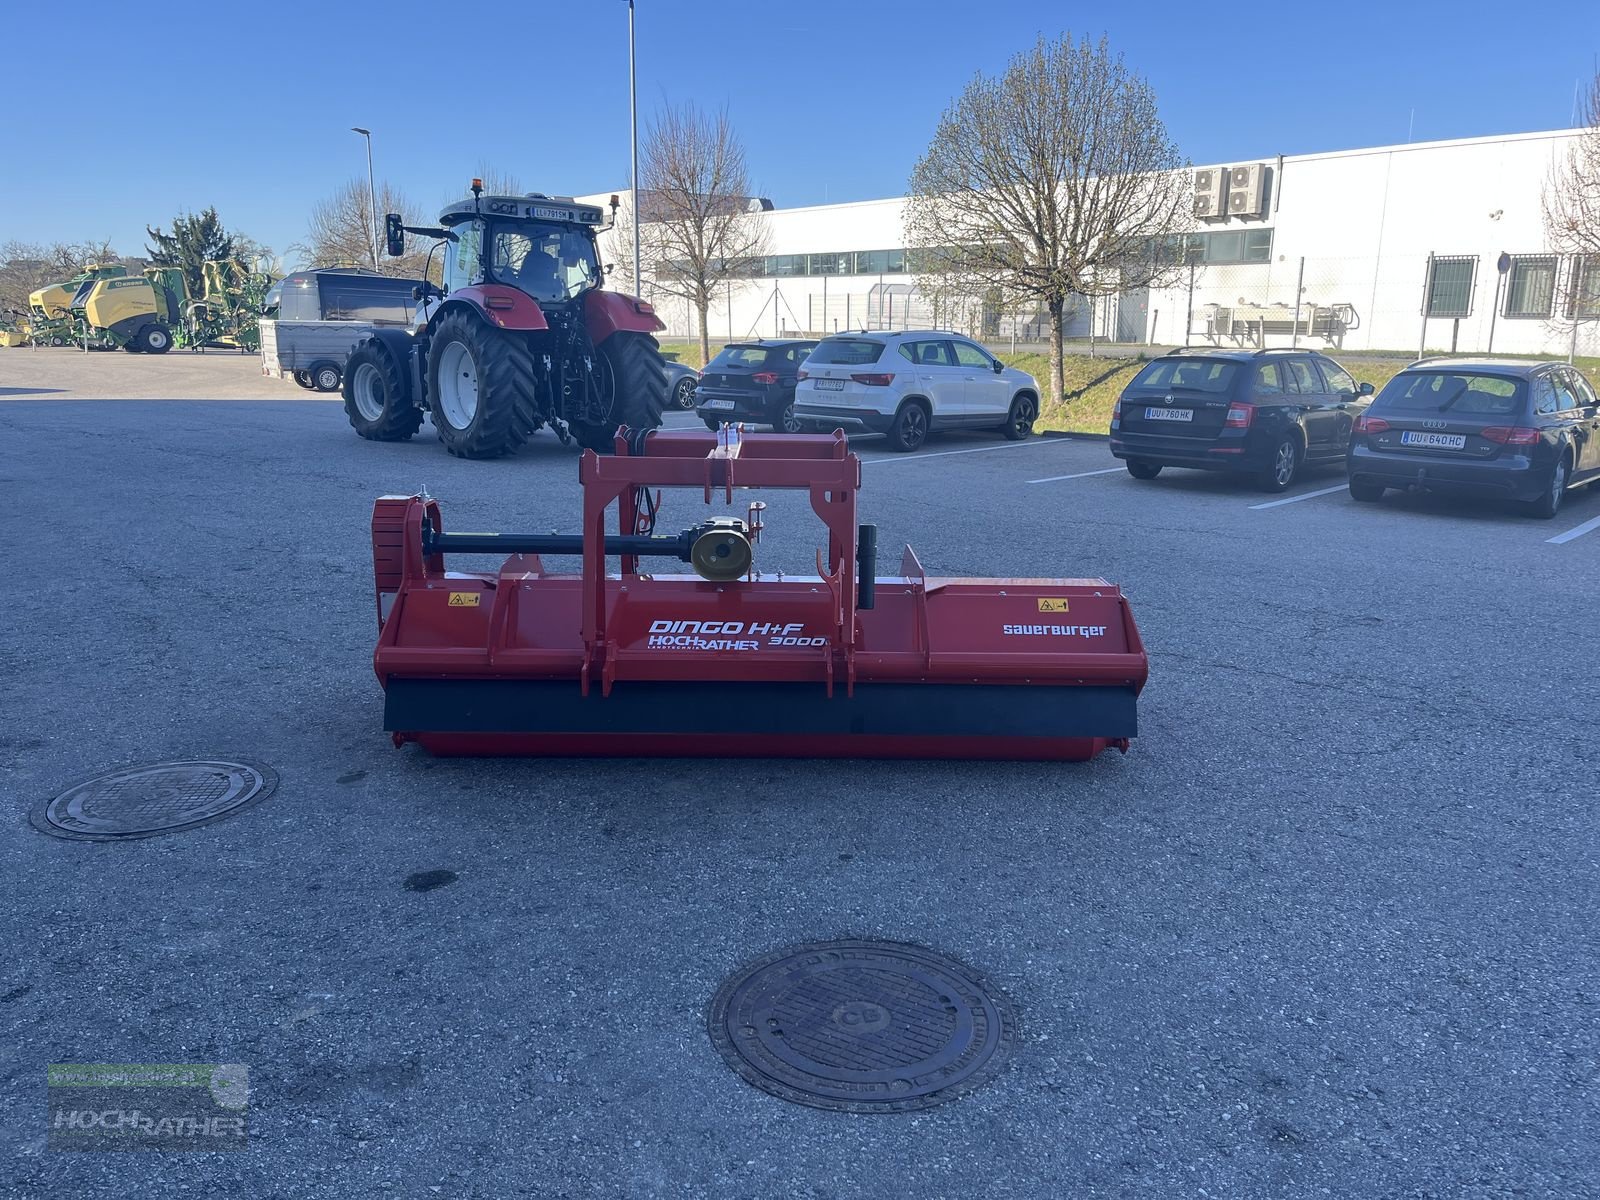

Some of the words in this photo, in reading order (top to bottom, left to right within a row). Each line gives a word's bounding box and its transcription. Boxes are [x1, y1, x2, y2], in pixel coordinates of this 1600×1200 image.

[1151, 409, 1161, 418] UU
[1410, 433, 1423, 443] UU
[1429, 434, 1448, 445] 640
[1448, 436, 1462, 446] HC
[648, 620, 745, 635] DINGO
[747, 622, 805, 636] H+F
[767, 636, 826, 647] 3000
